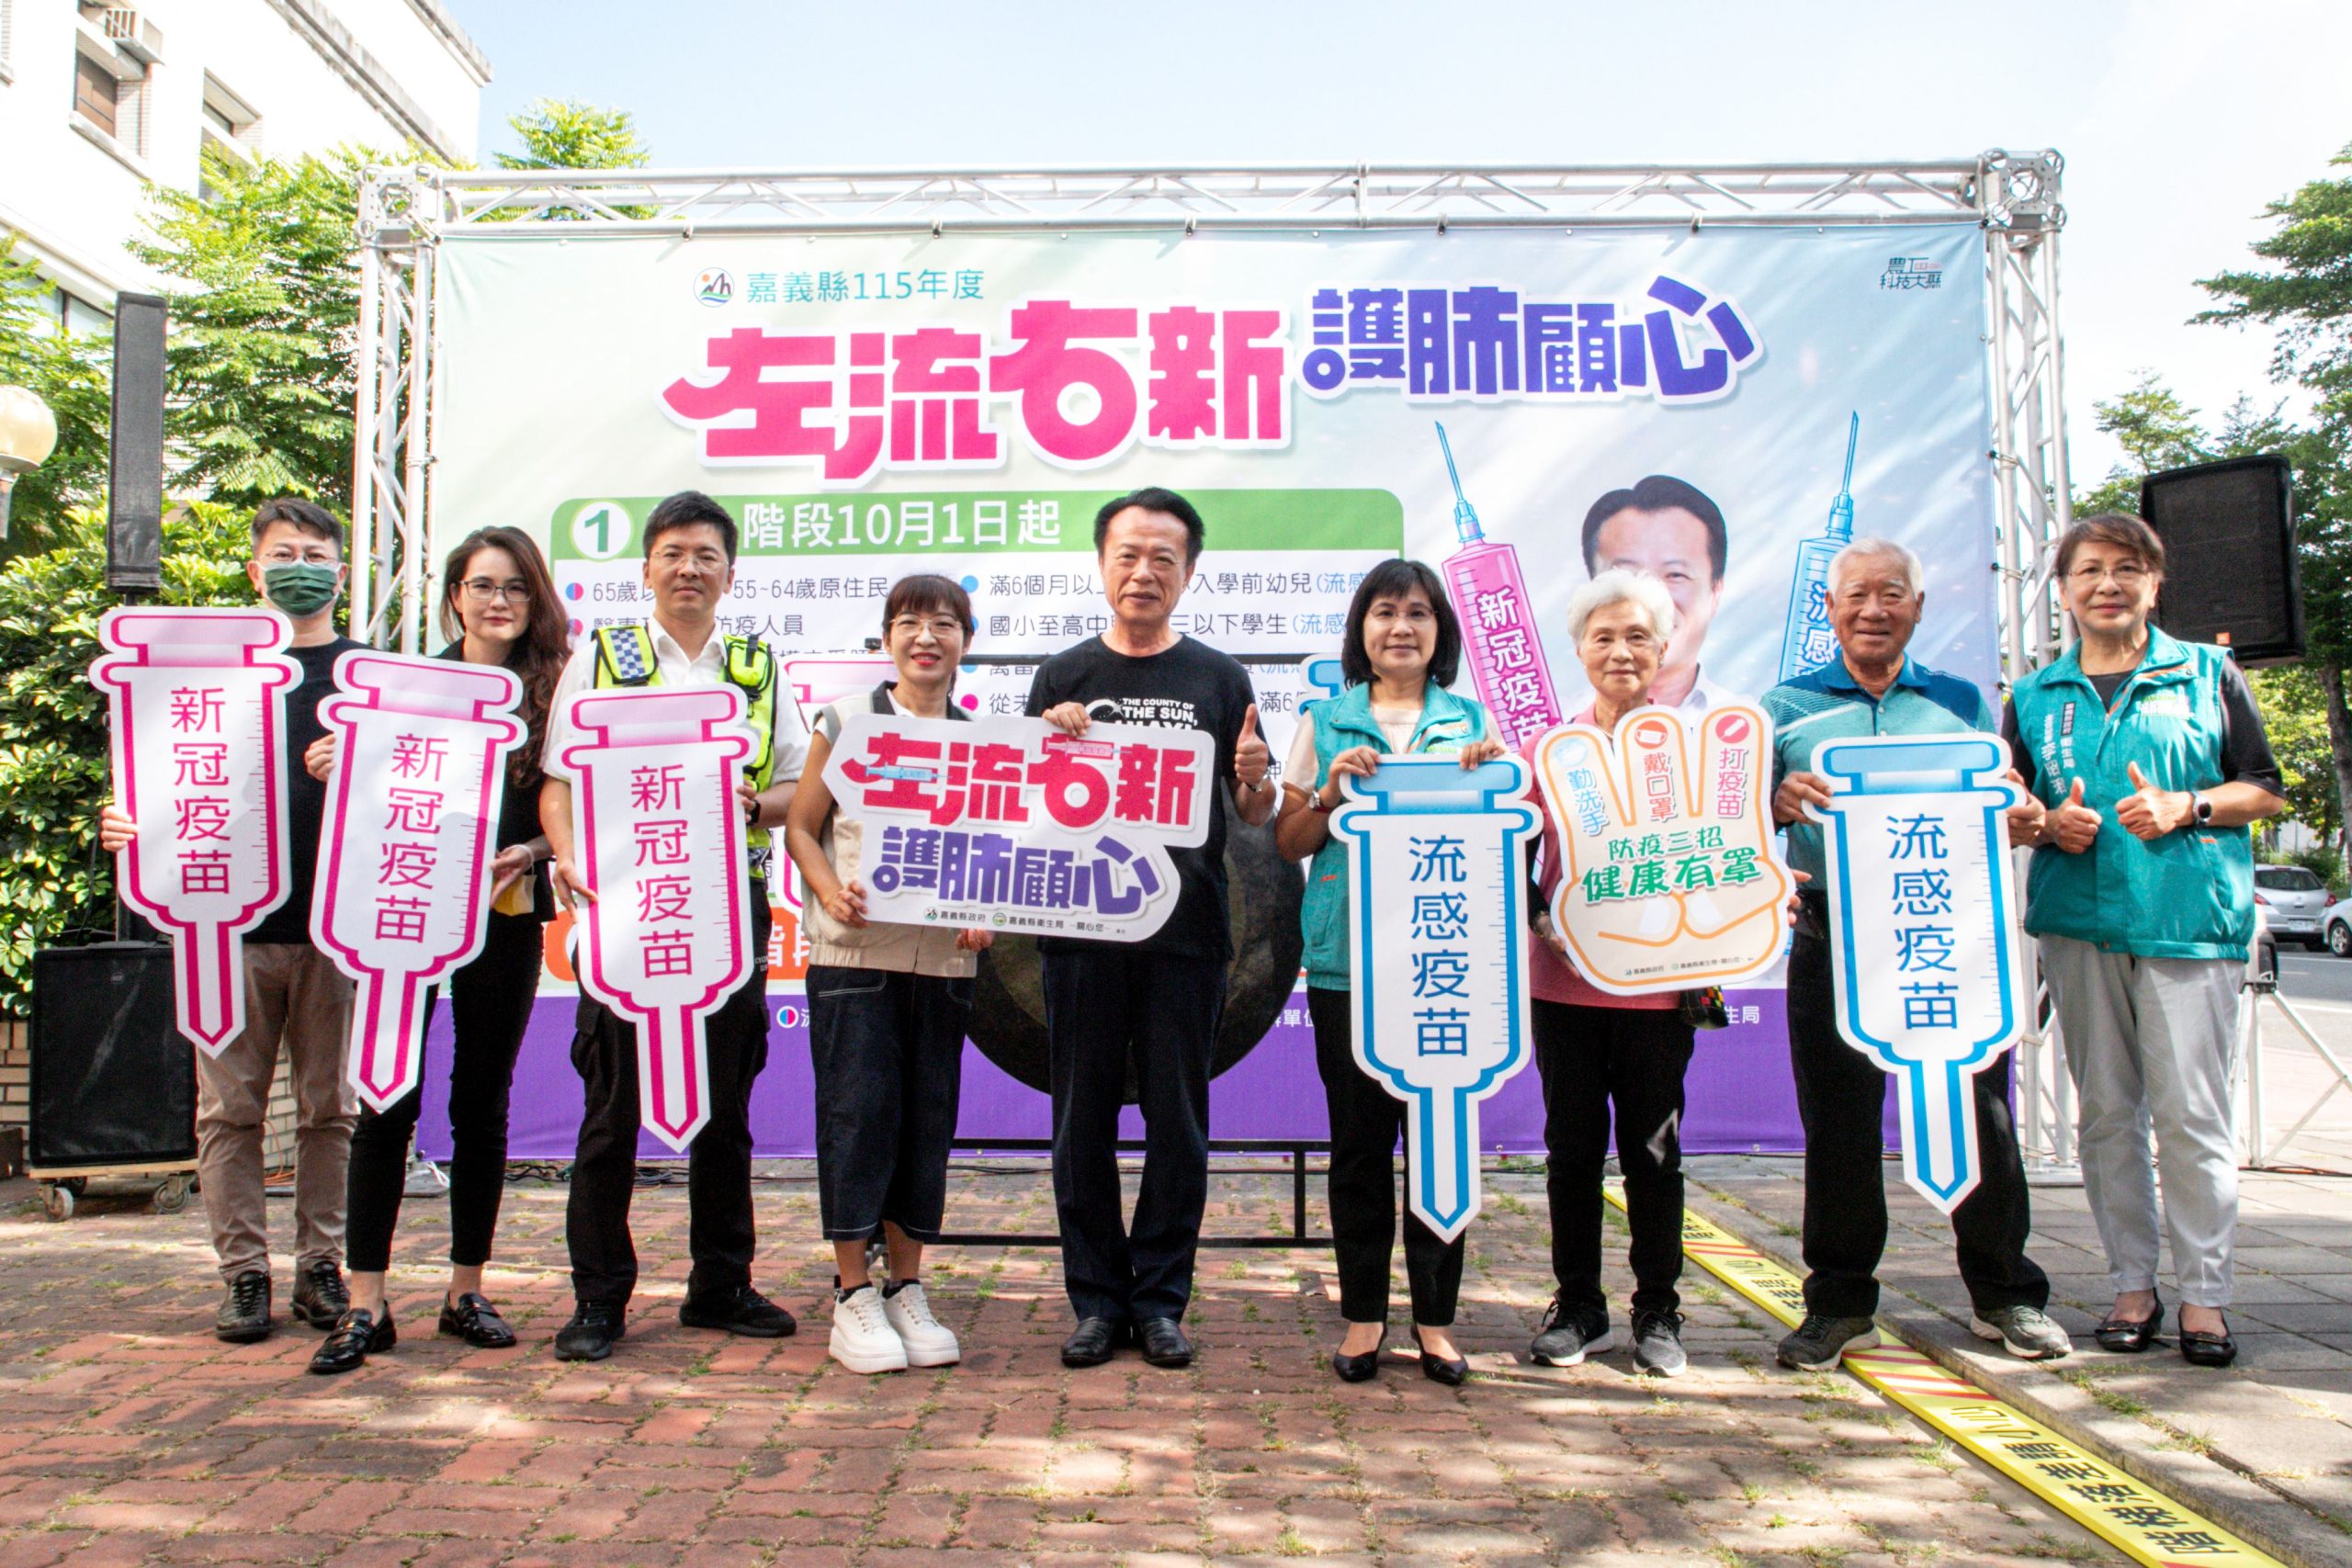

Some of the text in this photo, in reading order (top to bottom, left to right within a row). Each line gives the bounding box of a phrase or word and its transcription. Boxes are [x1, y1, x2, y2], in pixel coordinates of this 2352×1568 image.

[746, 268, 985, 304] 嘉義縣115年度
[662, 275, 1754, 479] 左流右新 護肺顧心
[584, 500, 1061, 552] 1 階段10月1日起
[1185, 572, 1366, 595] 入學前幼兒(流感
[990, 615, 1115, 637] 國小至高中
[1122, 705, 1156, 719] THE
[1159, 707, 1198, 727] SUN,
[1143, 699, 1182, 708] COUNTY
[1182, 702, 1195, 711] OF
[1260, 691, 1307, 713] 滿6
[170, 686, 232, 895] 新冠疫苗
[841, 731, 1195, 828] 左流右新
[1566, 766, 1607, 835] 勤洗手
[1643, 751, 1676, 821] 戴口罩
[1716, 747, 1746, 818] 打疫苗
[375, 733, 449, 944] 新冠疫苗
[630, 763, 694, 979] 新冠疫苗
[872, 824, 1160, 915] 護肺顧心
[1608, 826, 1725, 862] 防疫三招
[1581, 847, 1764, 903] 健康有罩
[1408, 834, 1471, 1057] 流感疫苗
[1886, 813, 1959, 1030] 流感疫苗
